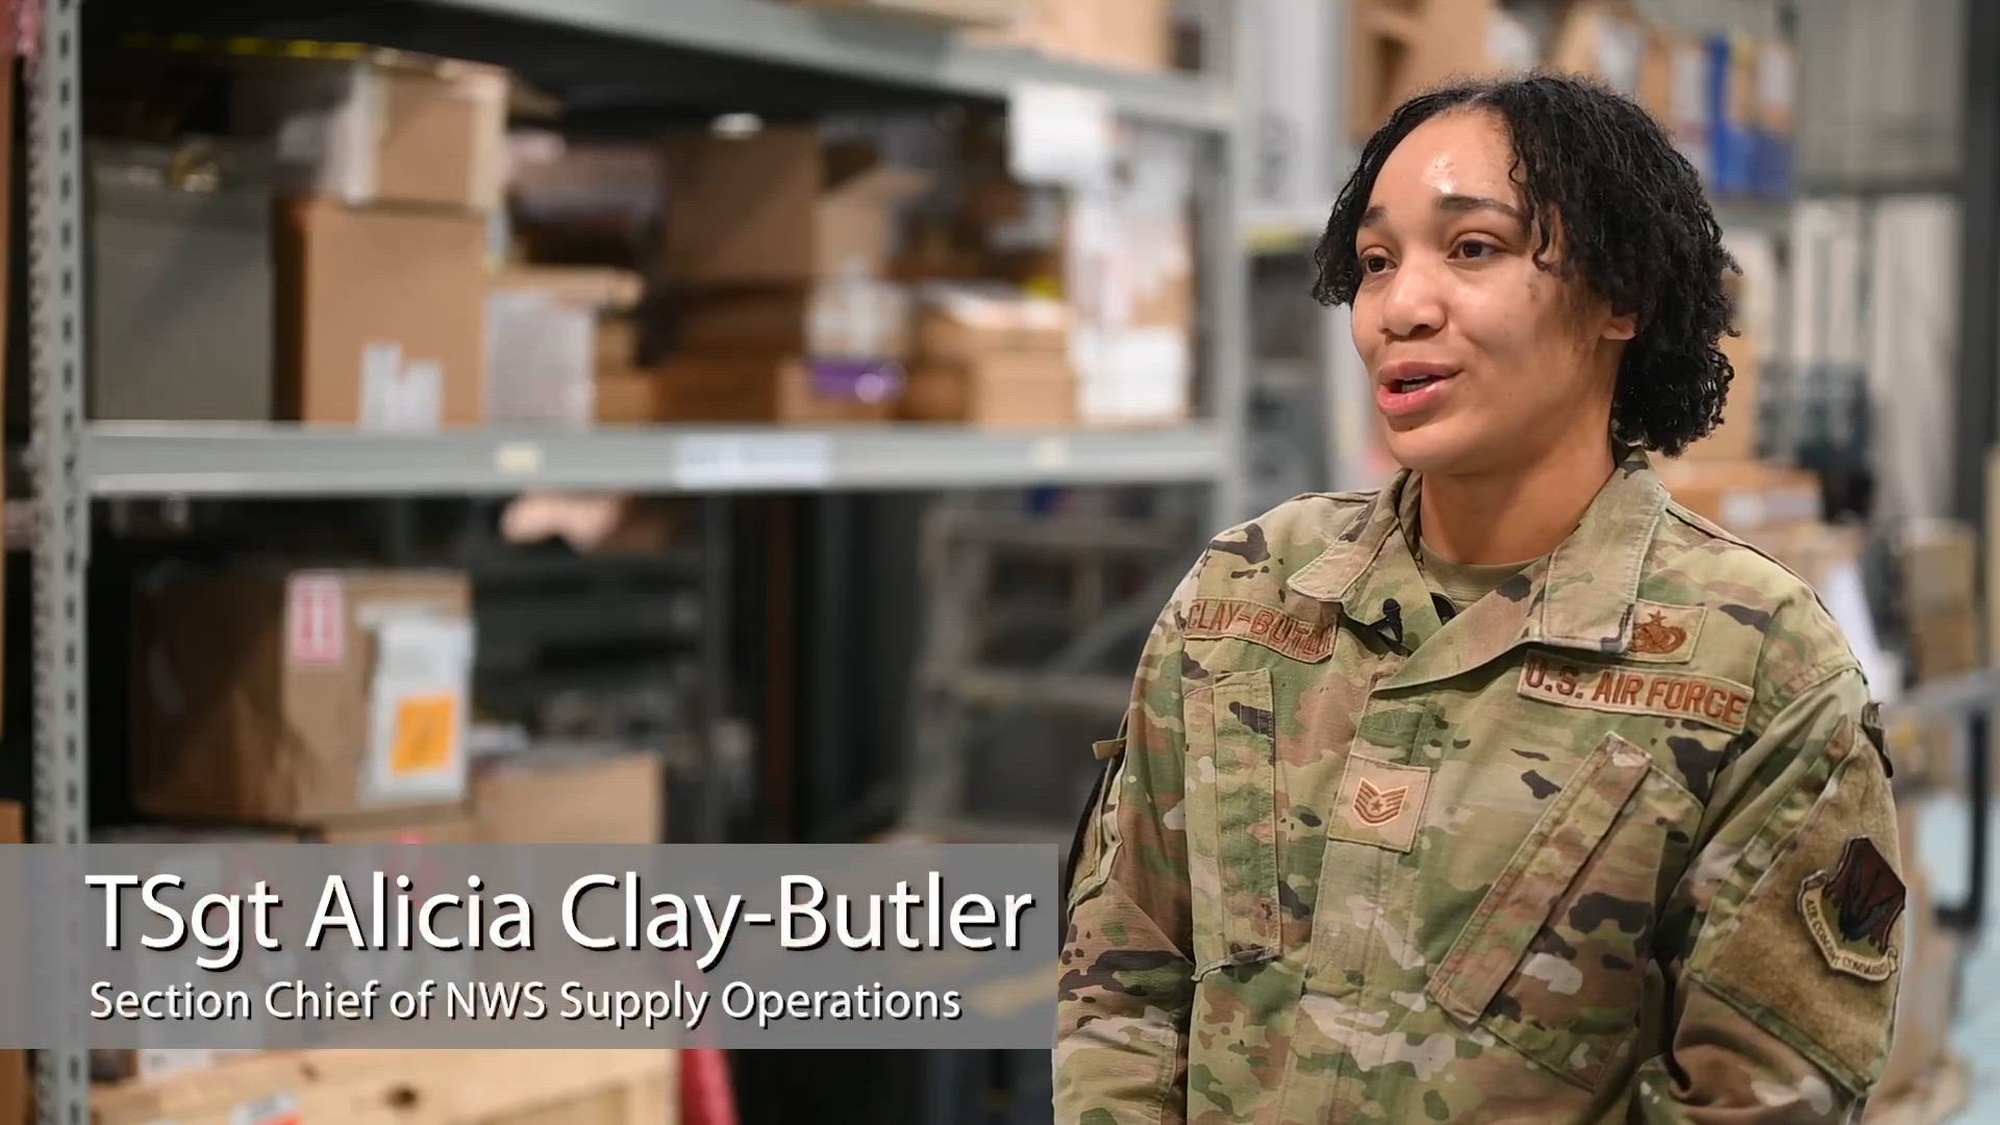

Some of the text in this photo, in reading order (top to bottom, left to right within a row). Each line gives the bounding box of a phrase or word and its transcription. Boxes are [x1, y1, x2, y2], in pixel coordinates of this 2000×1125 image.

[1525, 657, 1748, 726] U.S. AIR FORCE
